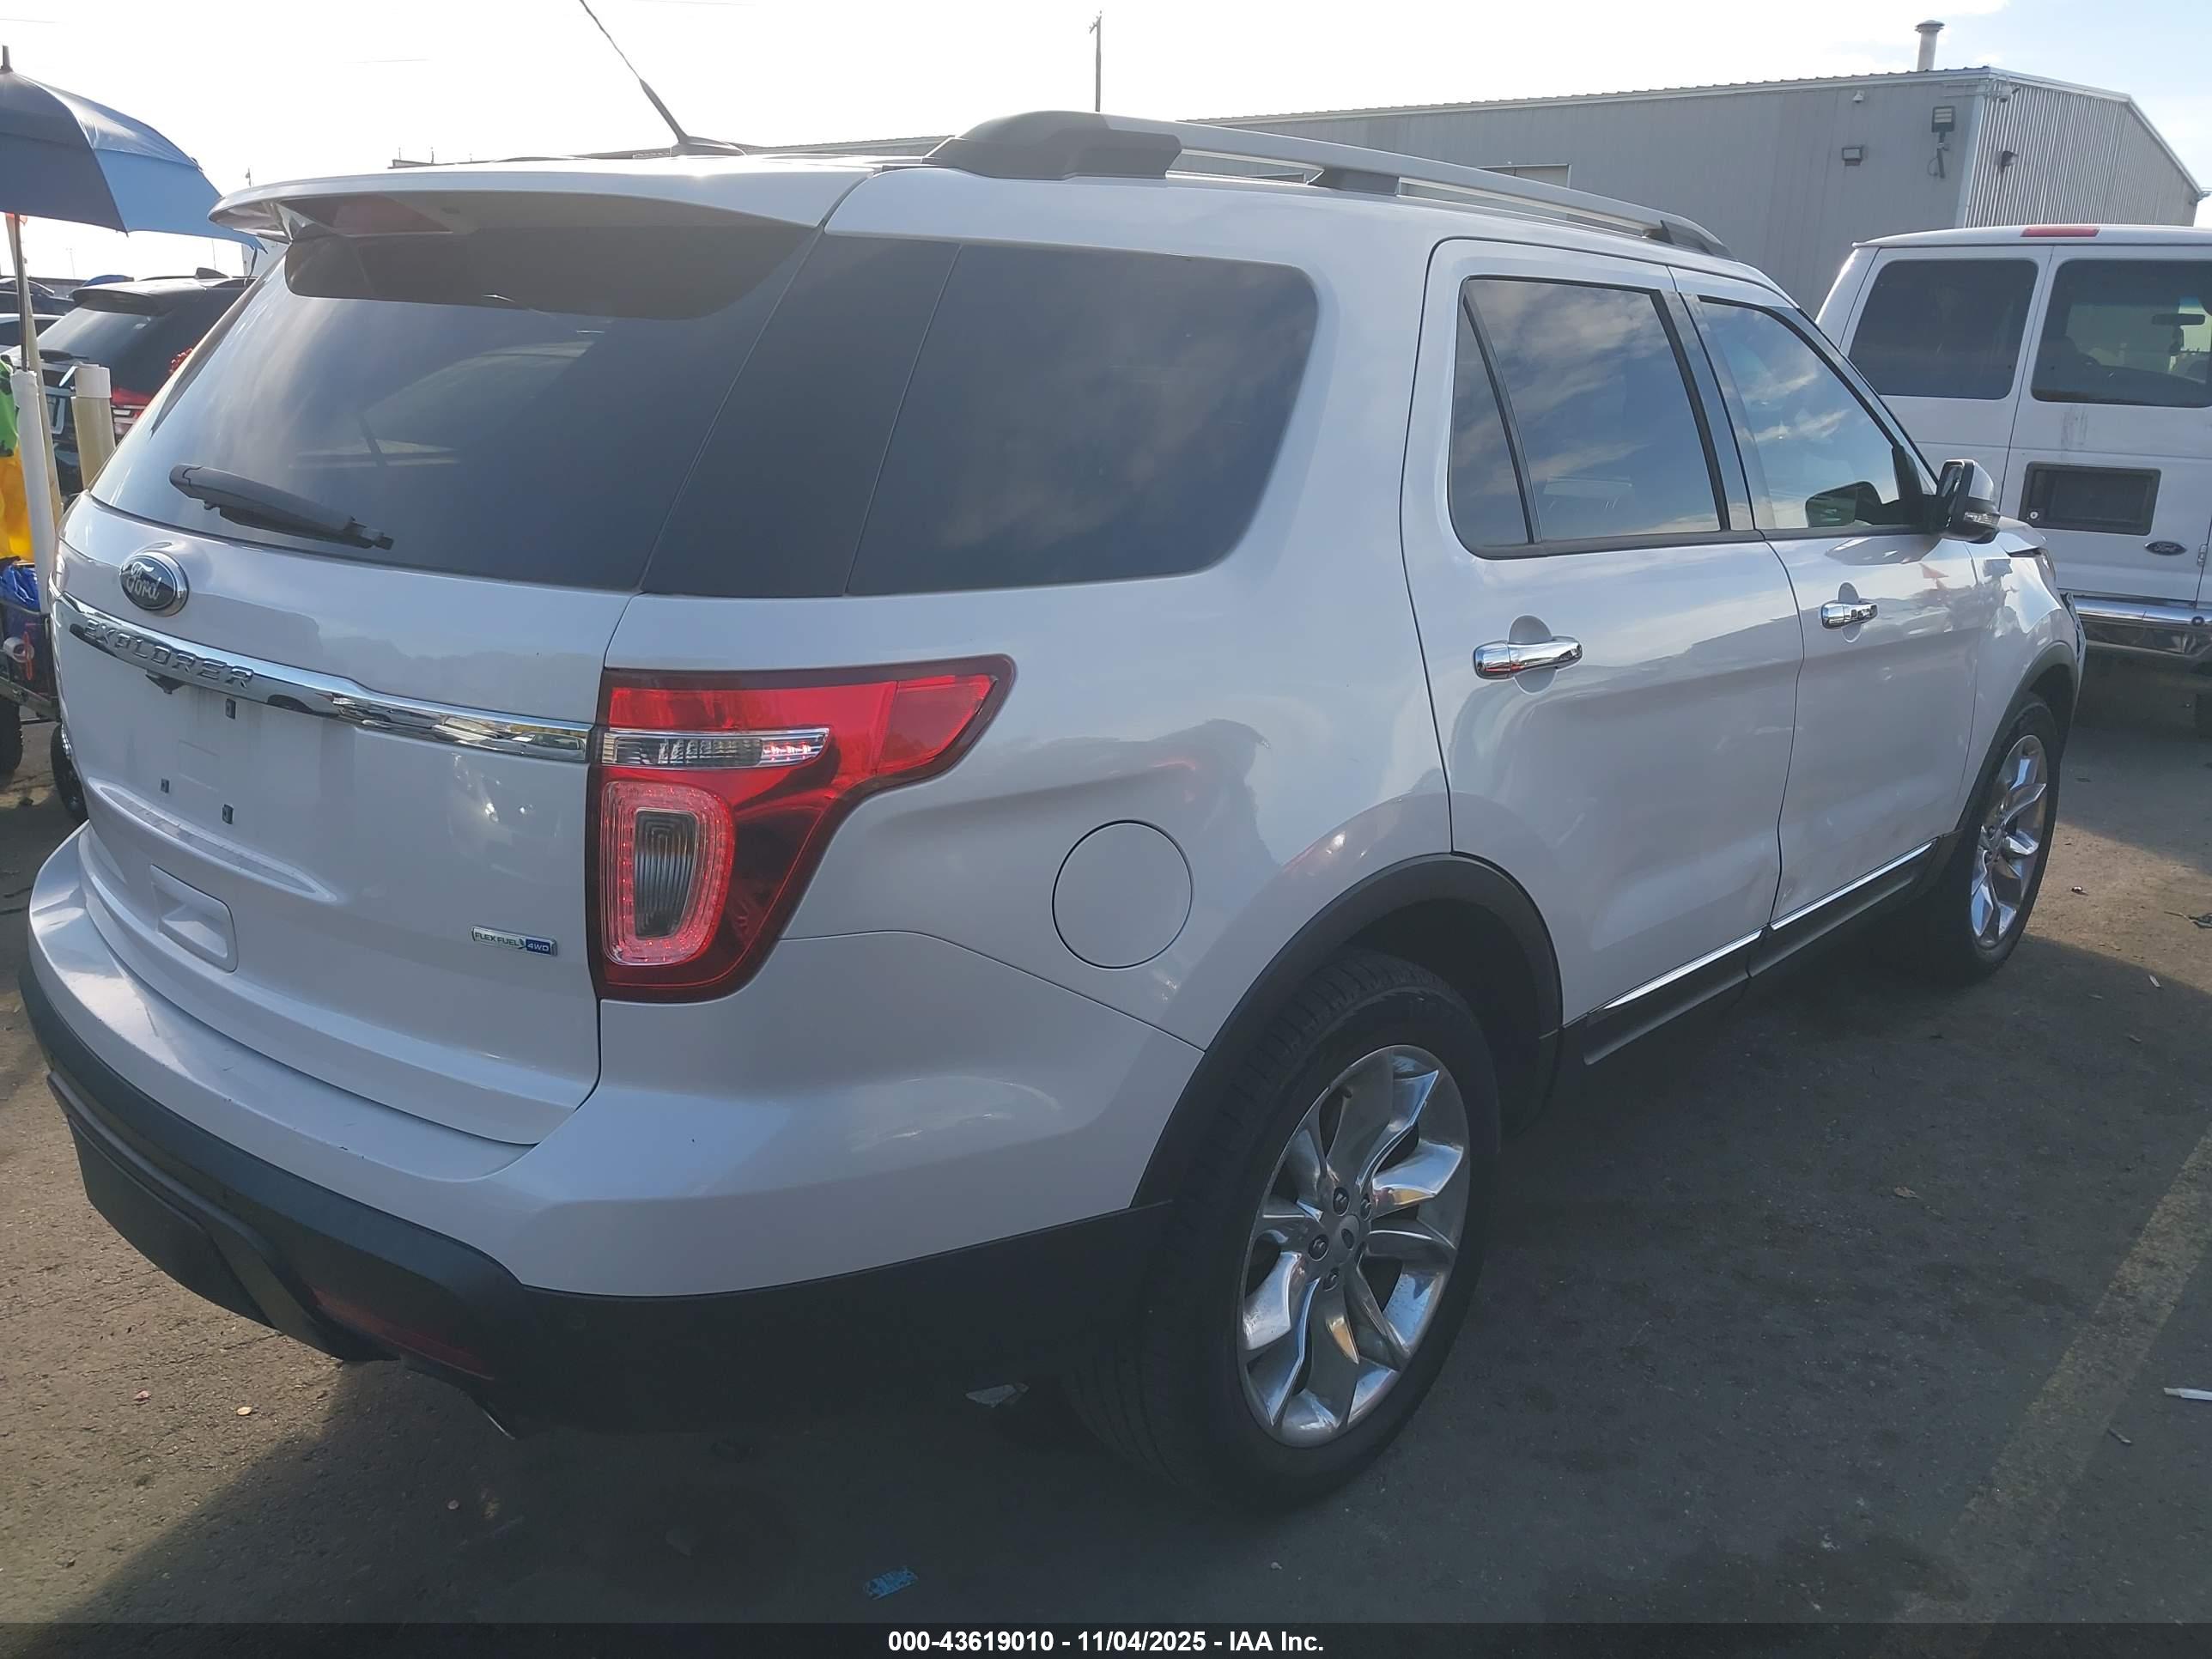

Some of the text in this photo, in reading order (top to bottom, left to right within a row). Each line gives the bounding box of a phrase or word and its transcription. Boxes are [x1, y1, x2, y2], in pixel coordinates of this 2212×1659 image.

[126, 561, 161, 600] Ford
[84, 618, 255, 689] EXPLORER
[475, 932, 550, 952] FLEX FUEL 4WD
